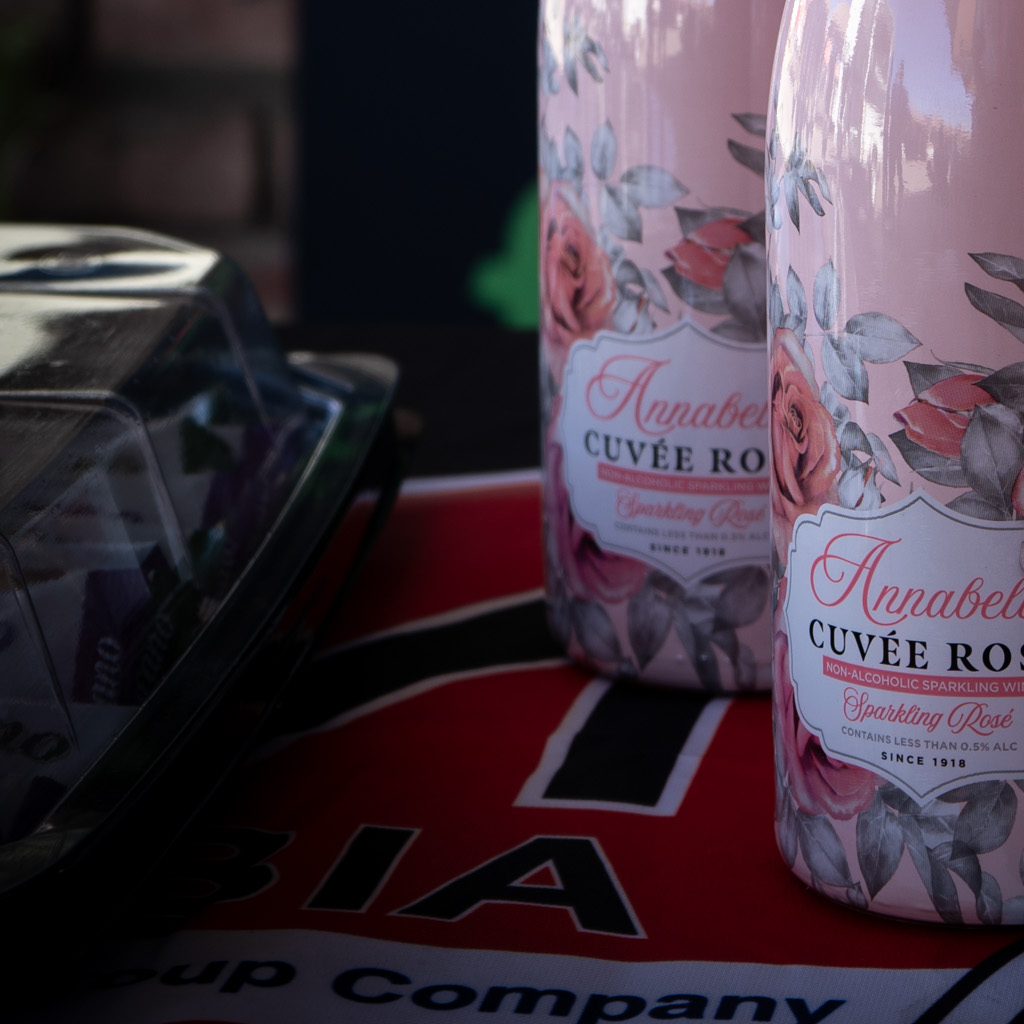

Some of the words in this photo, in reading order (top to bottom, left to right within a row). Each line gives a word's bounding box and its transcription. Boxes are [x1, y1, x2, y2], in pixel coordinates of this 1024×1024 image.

[584, 429, 694, 472] CUVÉE
[710, 446, 766, 474] RO
[809, 618, 929, 670] CUVÉE
[826, 661, 919, 690] NON-ALCOHOLIC
[922, 679, 999, 694] SPARKLING
[843, 686, 943, 733] Sparkling
[947, 702, 1014, 737] Rosé
[841, 726, 891, 744] CONTAINS
[894, 736, 921, 748] LESS
[924, 740, 957, 751] THAN
[960, 742, 989, 752] 0.5%
[993, 742, 1018, 752] ALC
[881, 751, 924, 766] SINCE
[933, 757, 966, 768] 1918
[92, 960, 296, 994] oup
[331, 967, 848, 1024] Company
